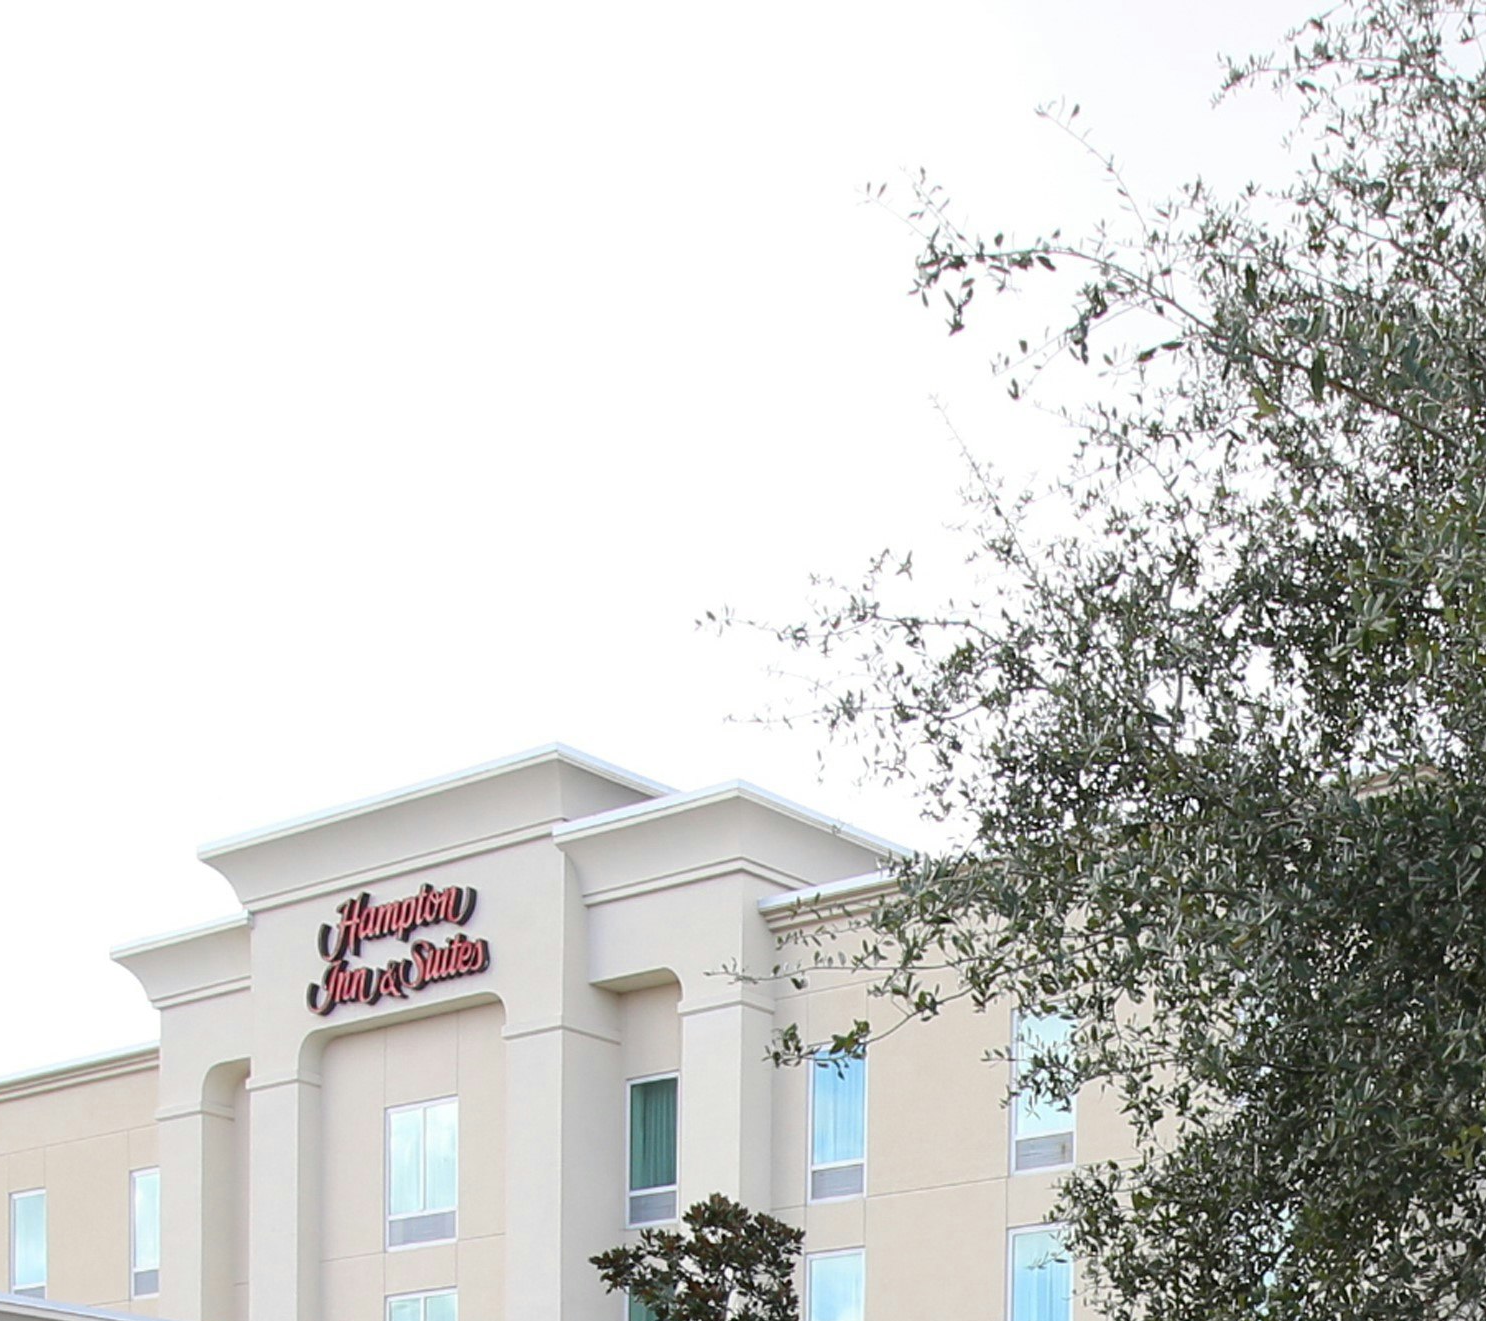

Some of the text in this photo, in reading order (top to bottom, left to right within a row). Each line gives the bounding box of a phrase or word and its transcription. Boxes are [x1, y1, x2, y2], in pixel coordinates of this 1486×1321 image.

[317, 883, 477, 963] Hampton
[306, 932, 490, 1016] Inn & Suites
